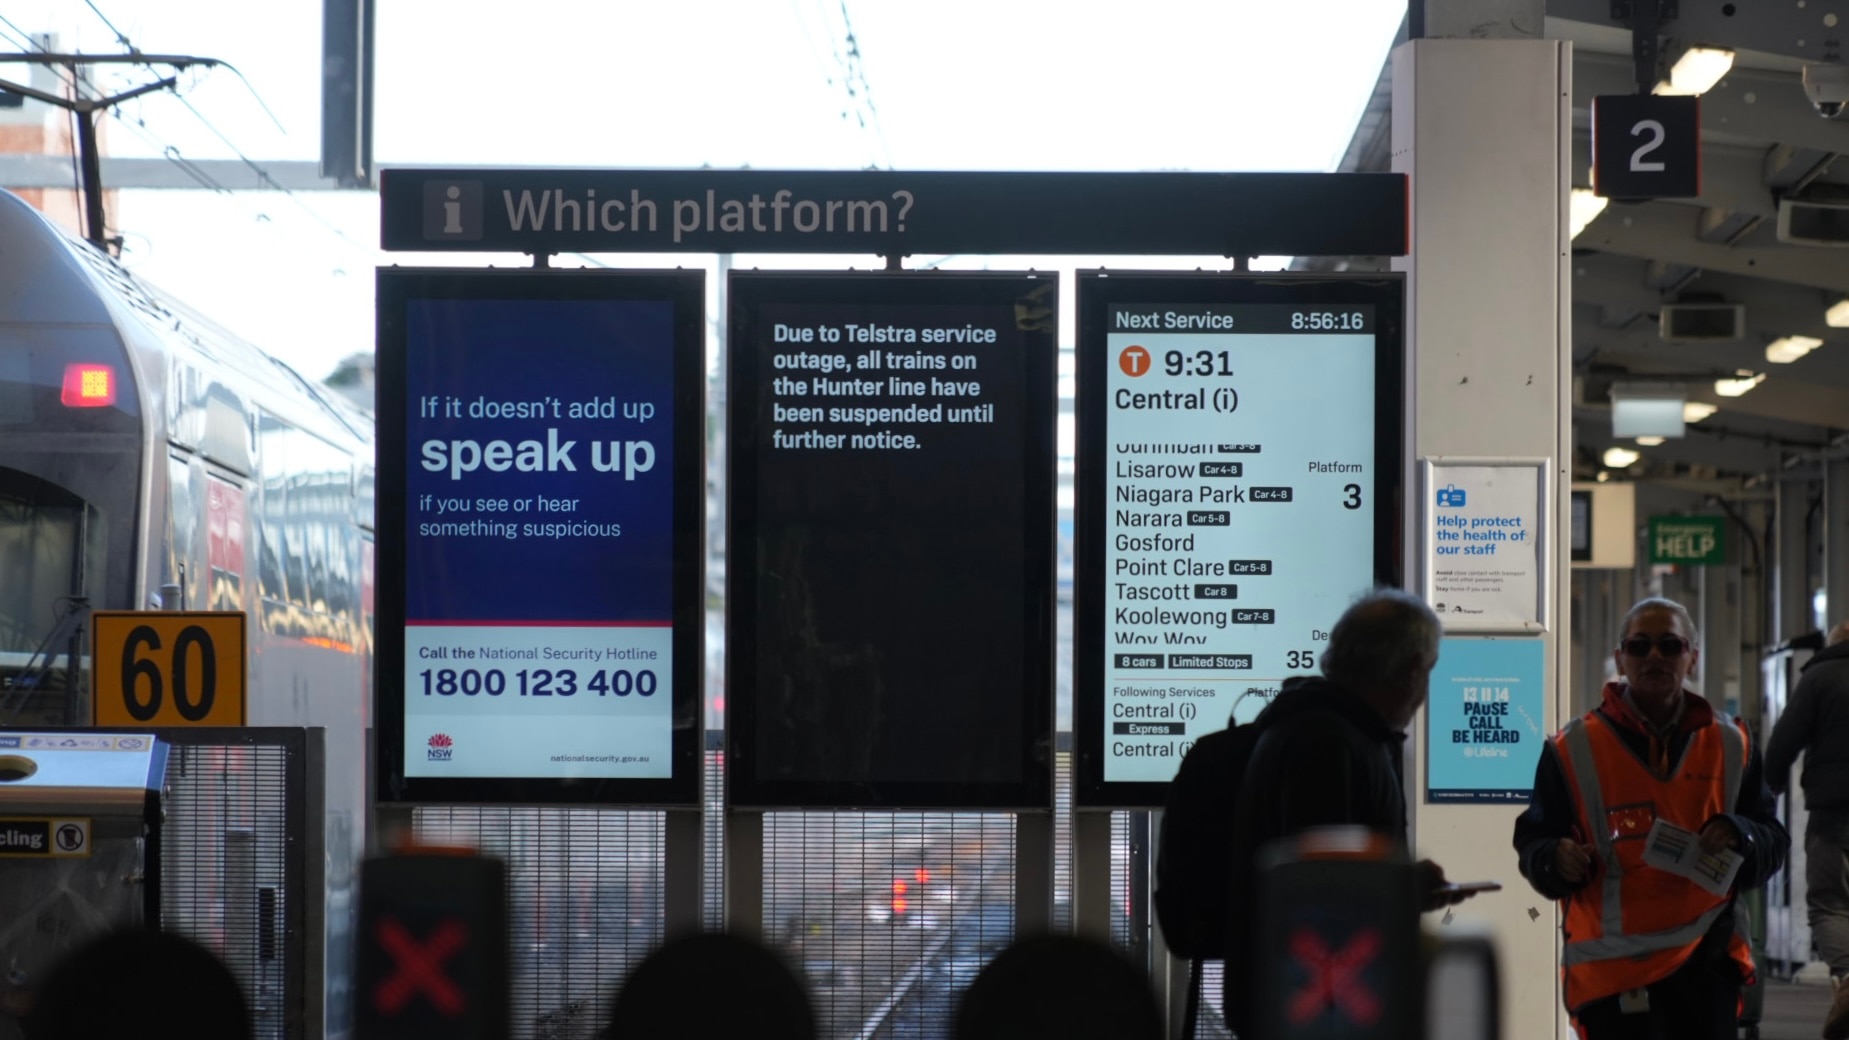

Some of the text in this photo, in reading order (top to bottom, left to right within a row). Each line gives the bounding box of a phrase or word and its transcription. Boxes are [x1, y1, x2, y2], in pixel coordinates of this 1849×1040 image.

[1630, 120, 1665, 172] 2
[504, 190, 914, 242] Which platform?
[1117, 312, 1363, 329] Next Service 8:56:16
[774, 322, 996, 343] Due to Telstra service
[773, 349, 976, 372] outage, all trains on
[1128, 351, 1233, 376] T 9:31
[773, 375, 980, 395] the Hunter line have
[1116, 388, 1238, 412] Central (i)
[420, 396, 654, 422] If it doesn't add up
[773, 402, 993, 425] been suspended until
[773, 428, 921, 449] further notice.
[420, 429, 655, 480] speak up
[1116, 461, 1195, 478] Lisarow
[1204, 466, 1238, 474] Car 4-8
[1309, 462, 1362, 472] Platform
[1117, 486, 1245, 506] Niagara Park
[1254, 490, 1287, 499] Car 4-8
[1343, 484, 1362, 509] 3
[420, 495, 578, 515] if you see or hear
[1117, 510, 1182, 527] Narara
[1192, 514, 1225, 523] Car 5-8
[1437, 515, 1521, 527] Help protect
[420, 518, 621, 540] something suspicious
[1437, 529, 1526, 541] the health of
[1116, 534, 1194, 551] Gosford
[1437, 543, 1496, 555] our staff
[1657, 537, 1715, 558] HELP
[1116, 558, 1224, 576] Point Clare
[1234, 564, 1267, 572] Car 5-8
[1116, 583, 1190, 600] Tascott
[1204, 588, 1227, 596] Car 8
[1116, 608, 1227, 629] Koolewong
[1237, 612, 1269, 621] Car 7-8
[420, 647, 657, 663] Call the National Security Hotline
[1122, 657, 1156, 667] 8 cars
[1173, 657, 1248, 669] Limited Stops
[1287, 651, 1314, 668] 35
[121, 626, 216, 721] 60
[420, 669, 656, 696] 1800 123 400
[1114, 688, 1215, 699] Following Services
[1247, 688, 1280, 698] Platfo
[1113, 702, 1196, 720] Central (i)
[1129, 724, 1169, 734] Express
[1469, 717, 1503, 729] CALL
[1453, 730, 1520, 743] BE HEARD
[1113, 742, 1174, 757] Central
[1475, 747, 1508, 757] Lifeline
[551, 755, 649, 763] nationalsecurity.gov.au
